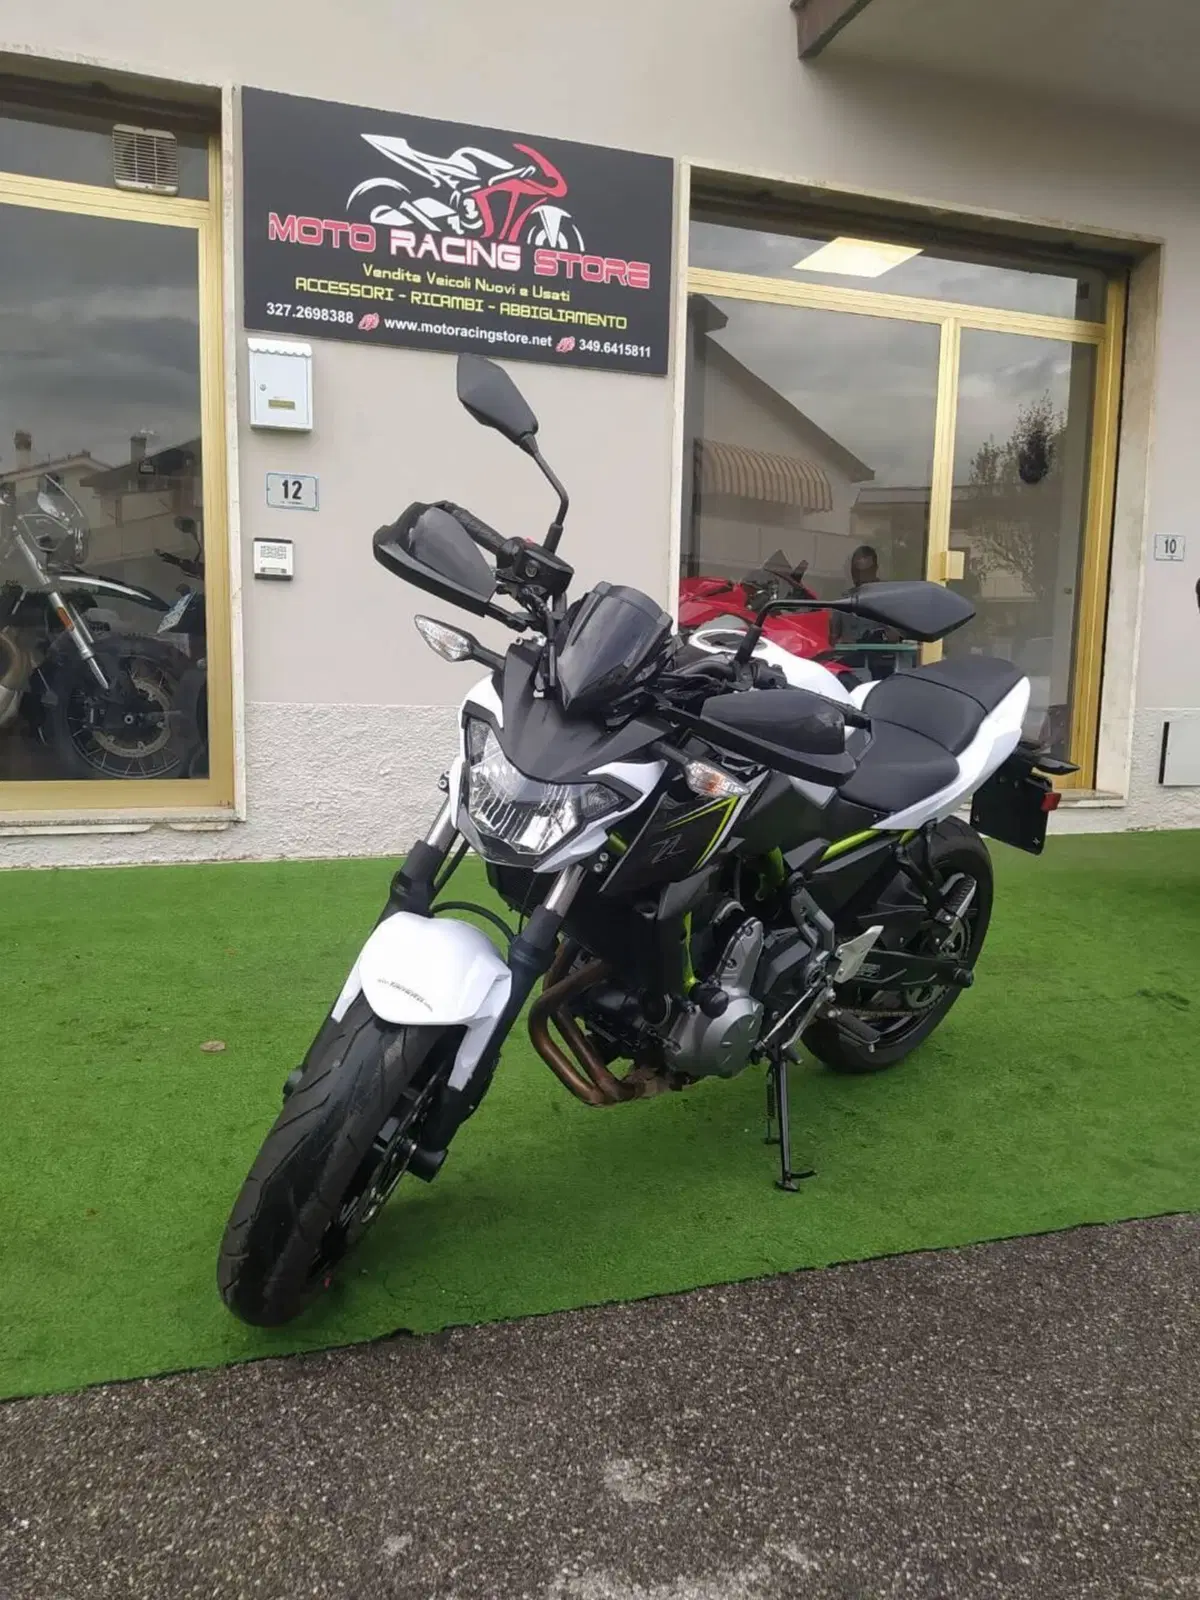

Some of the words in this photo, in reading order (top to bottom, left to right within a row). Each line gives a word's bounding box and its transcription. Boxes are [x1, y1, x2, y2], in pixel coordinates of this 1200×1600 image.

[268, 212, 376, 253] MOTO
[389, 228, 522, 272] RACING
[534, 248, 651, 289] STORE
[295, 276, 395, 302] ACCESSORI
[410, 290, 484, 312] RICAMBI
[500, 301, 628, 330] ABBIGLIAMENTO
[363, 263, 422, 283] Vendita
[426, 271, 471, 289] Veicoli
[475, 278, 516, 296] Nuovi
[519, 287, 529, 297] e
[532, 285, 571, 302] Usati
[266, 302, 355, 325] 327.2698388
[384, 317, 553, 348] www.motoracingstore.net
[578, 338, 651, 358] 349.6415811
[282, 479, 303, 500] 12
[1164, 538, 1177, 554] 10
